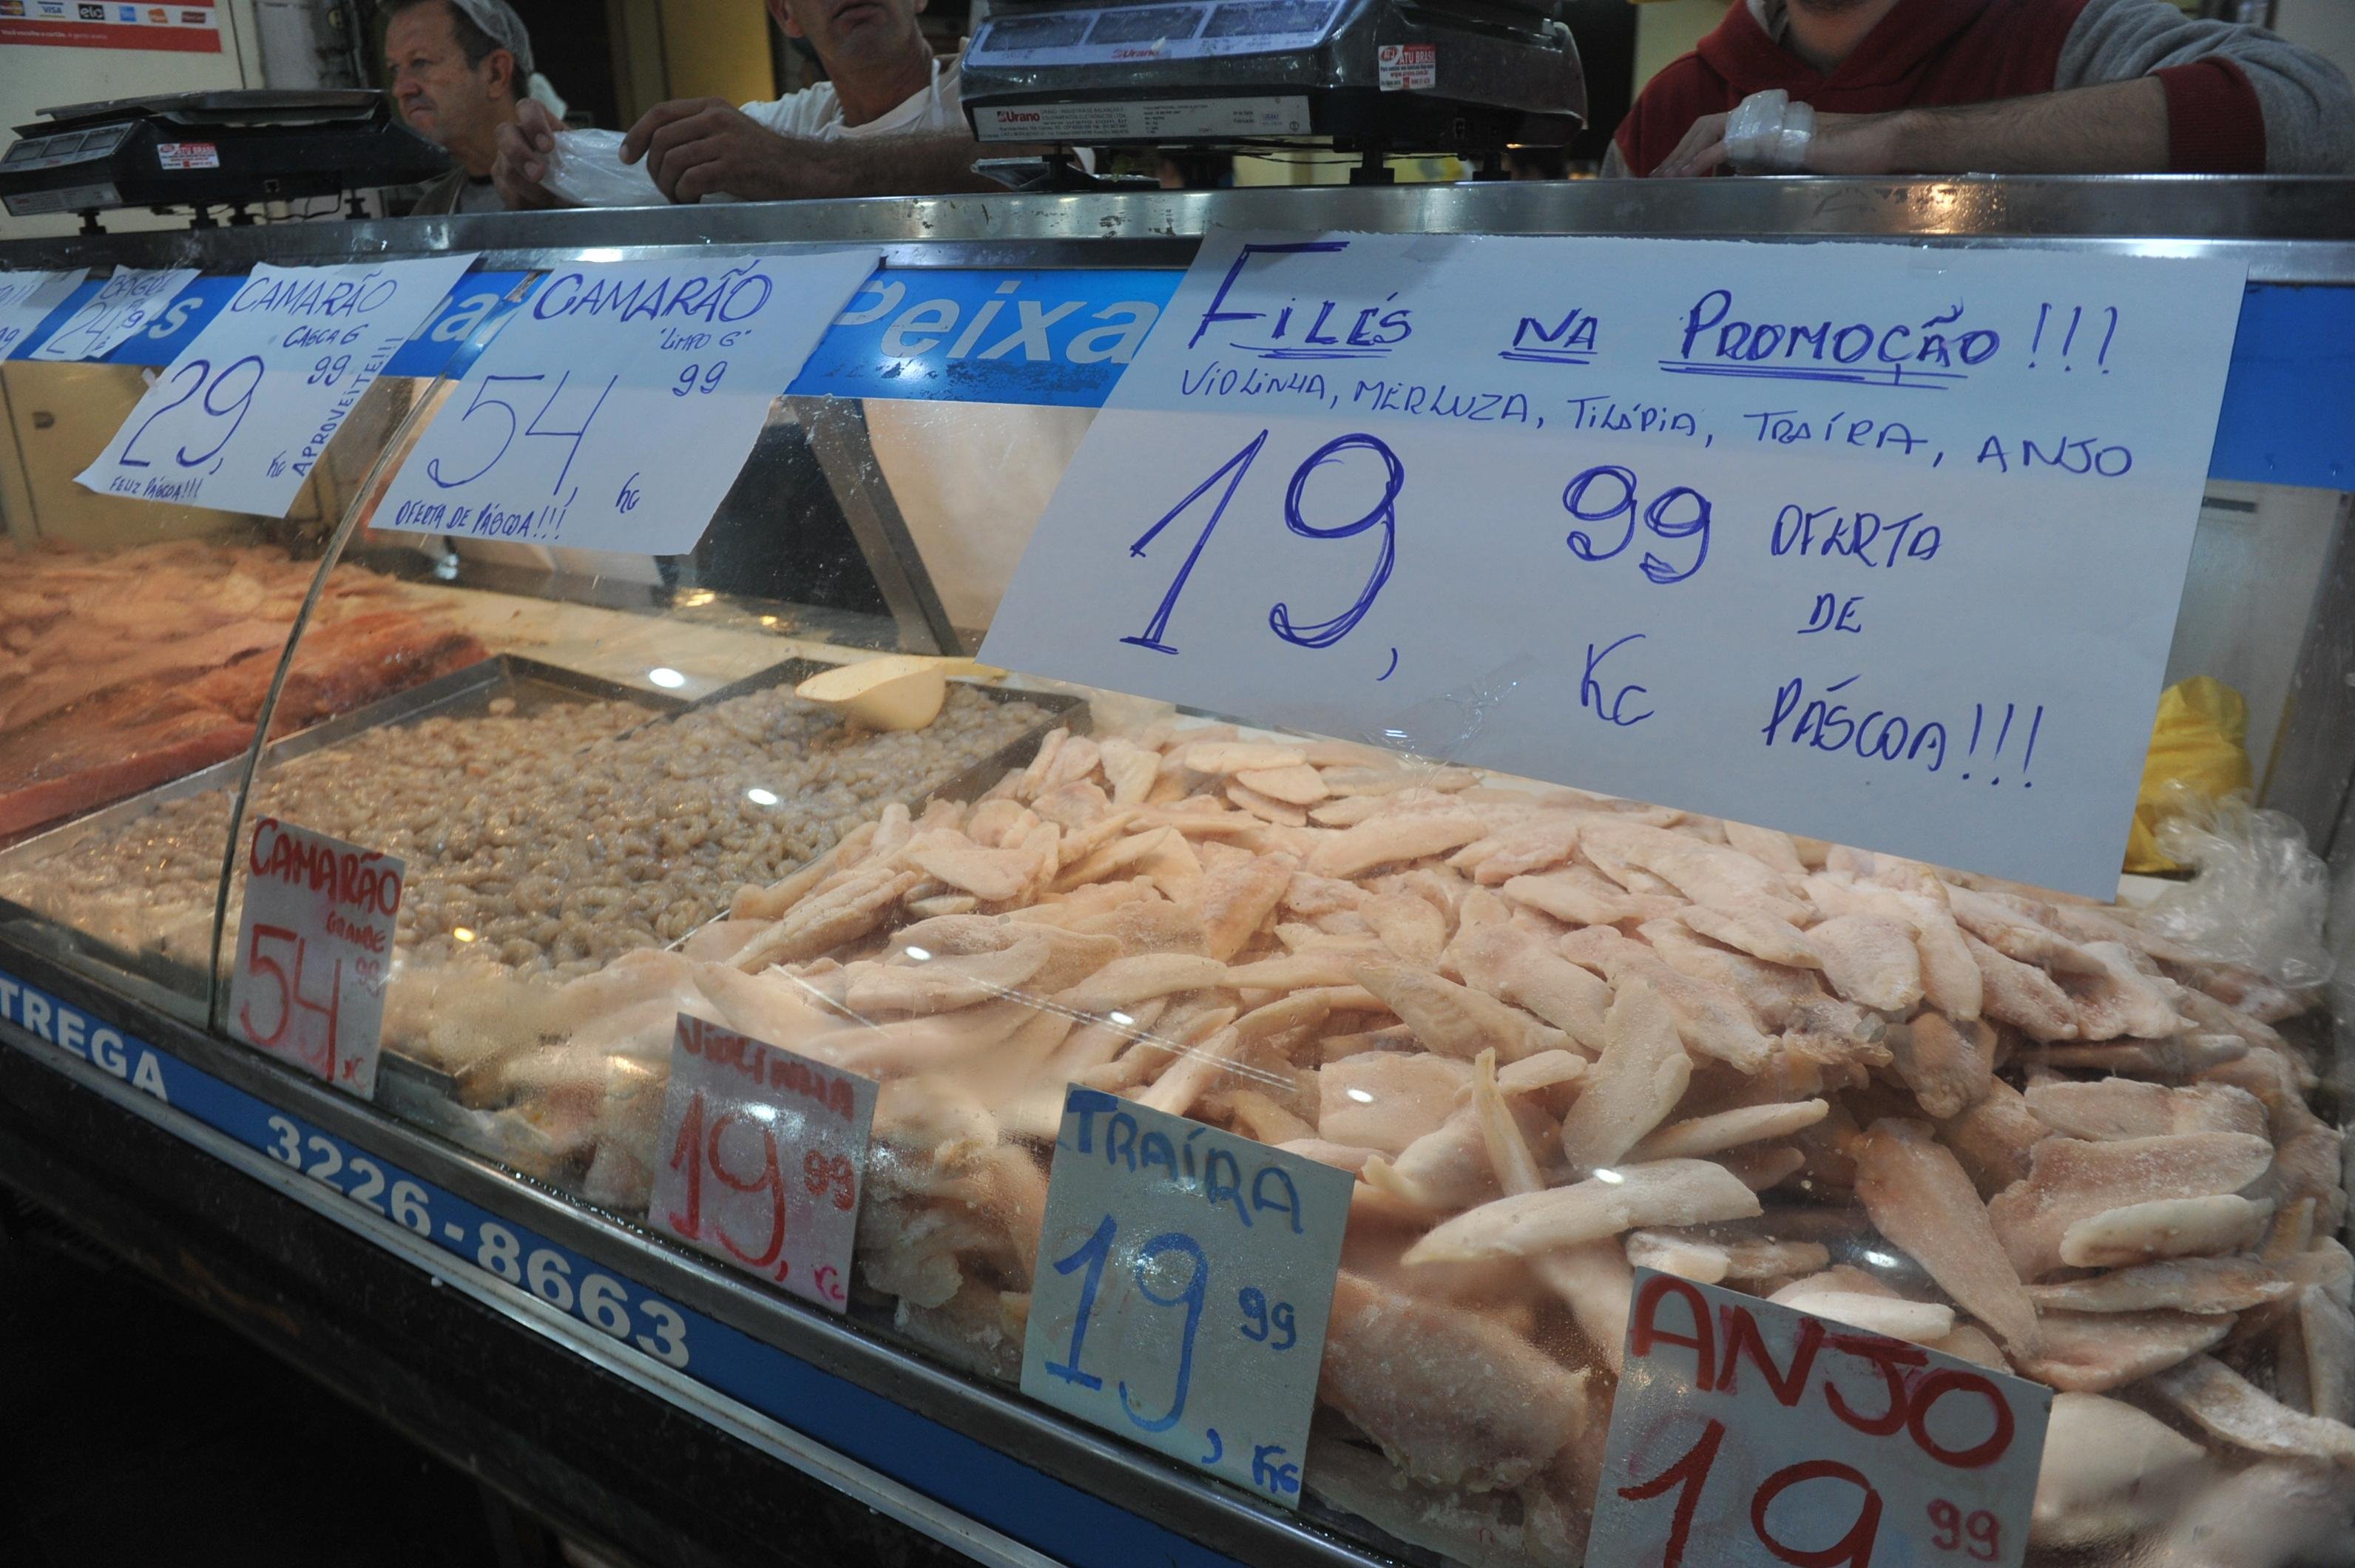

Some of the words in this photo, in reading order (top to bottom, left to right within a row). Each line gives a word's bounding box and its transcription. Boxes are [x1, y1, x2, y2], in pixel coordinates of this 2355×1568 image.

[1007, 112, 1040, 122] Urano
[231, 268, 397, 317] CAMARÃO
[533, 260, 772, 322] CAMARÃO
[1511, 307, 1598, 350] NA
[672, 360, 729, 396] 99
[1977, 435, 2132, 476] ANJO
[446, 505, 473, 529] DE
[1562, 464, 1712, 584] 99
[1771, 504, 1945, 568] OFERTA
[1797, 593, 1865, 634] DE
[249, 818, 404, 916] CAMARÃO
[240, 923, 342, 1083] 54
[1067, 1090, 1304, 1234] TRAÍRA
[266, 1115, 690, 1369] 3226-8663
[1238, 1287, 1296, 1351] 99
[1629, 1274, 2015, 1469] ANJO
[1927, 1498, 2001, 1562] 99
